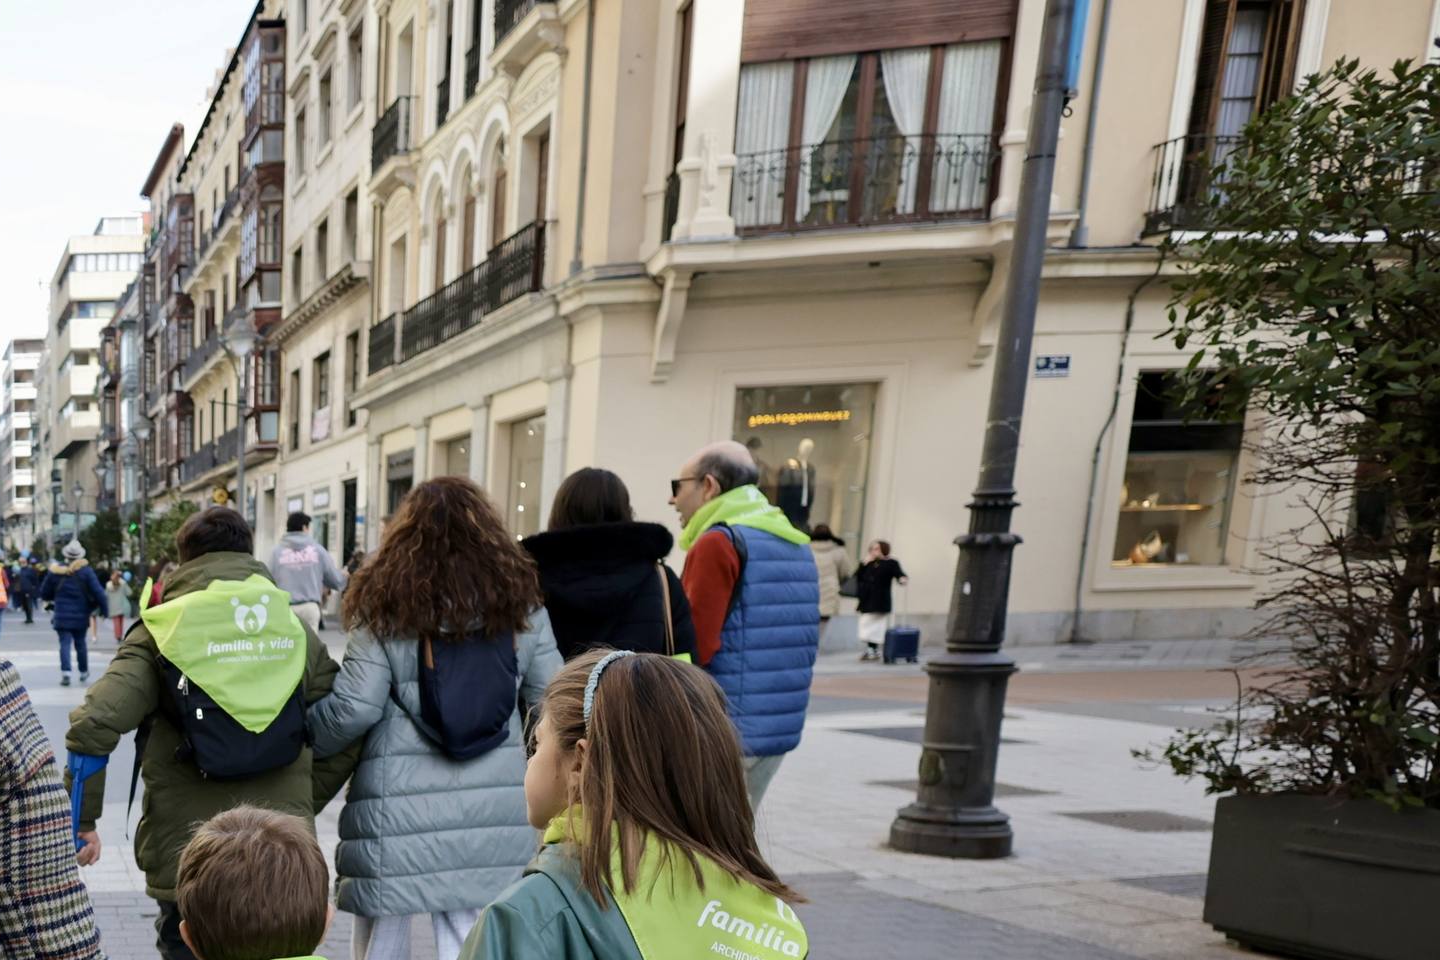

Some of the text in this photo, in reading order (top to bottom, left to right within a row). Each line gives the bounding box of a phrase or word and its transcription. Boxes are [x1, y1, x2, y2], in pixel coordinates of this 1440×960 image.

[207, 636, 295, 657] familia vida
[696, 899, 800, 957] familia
